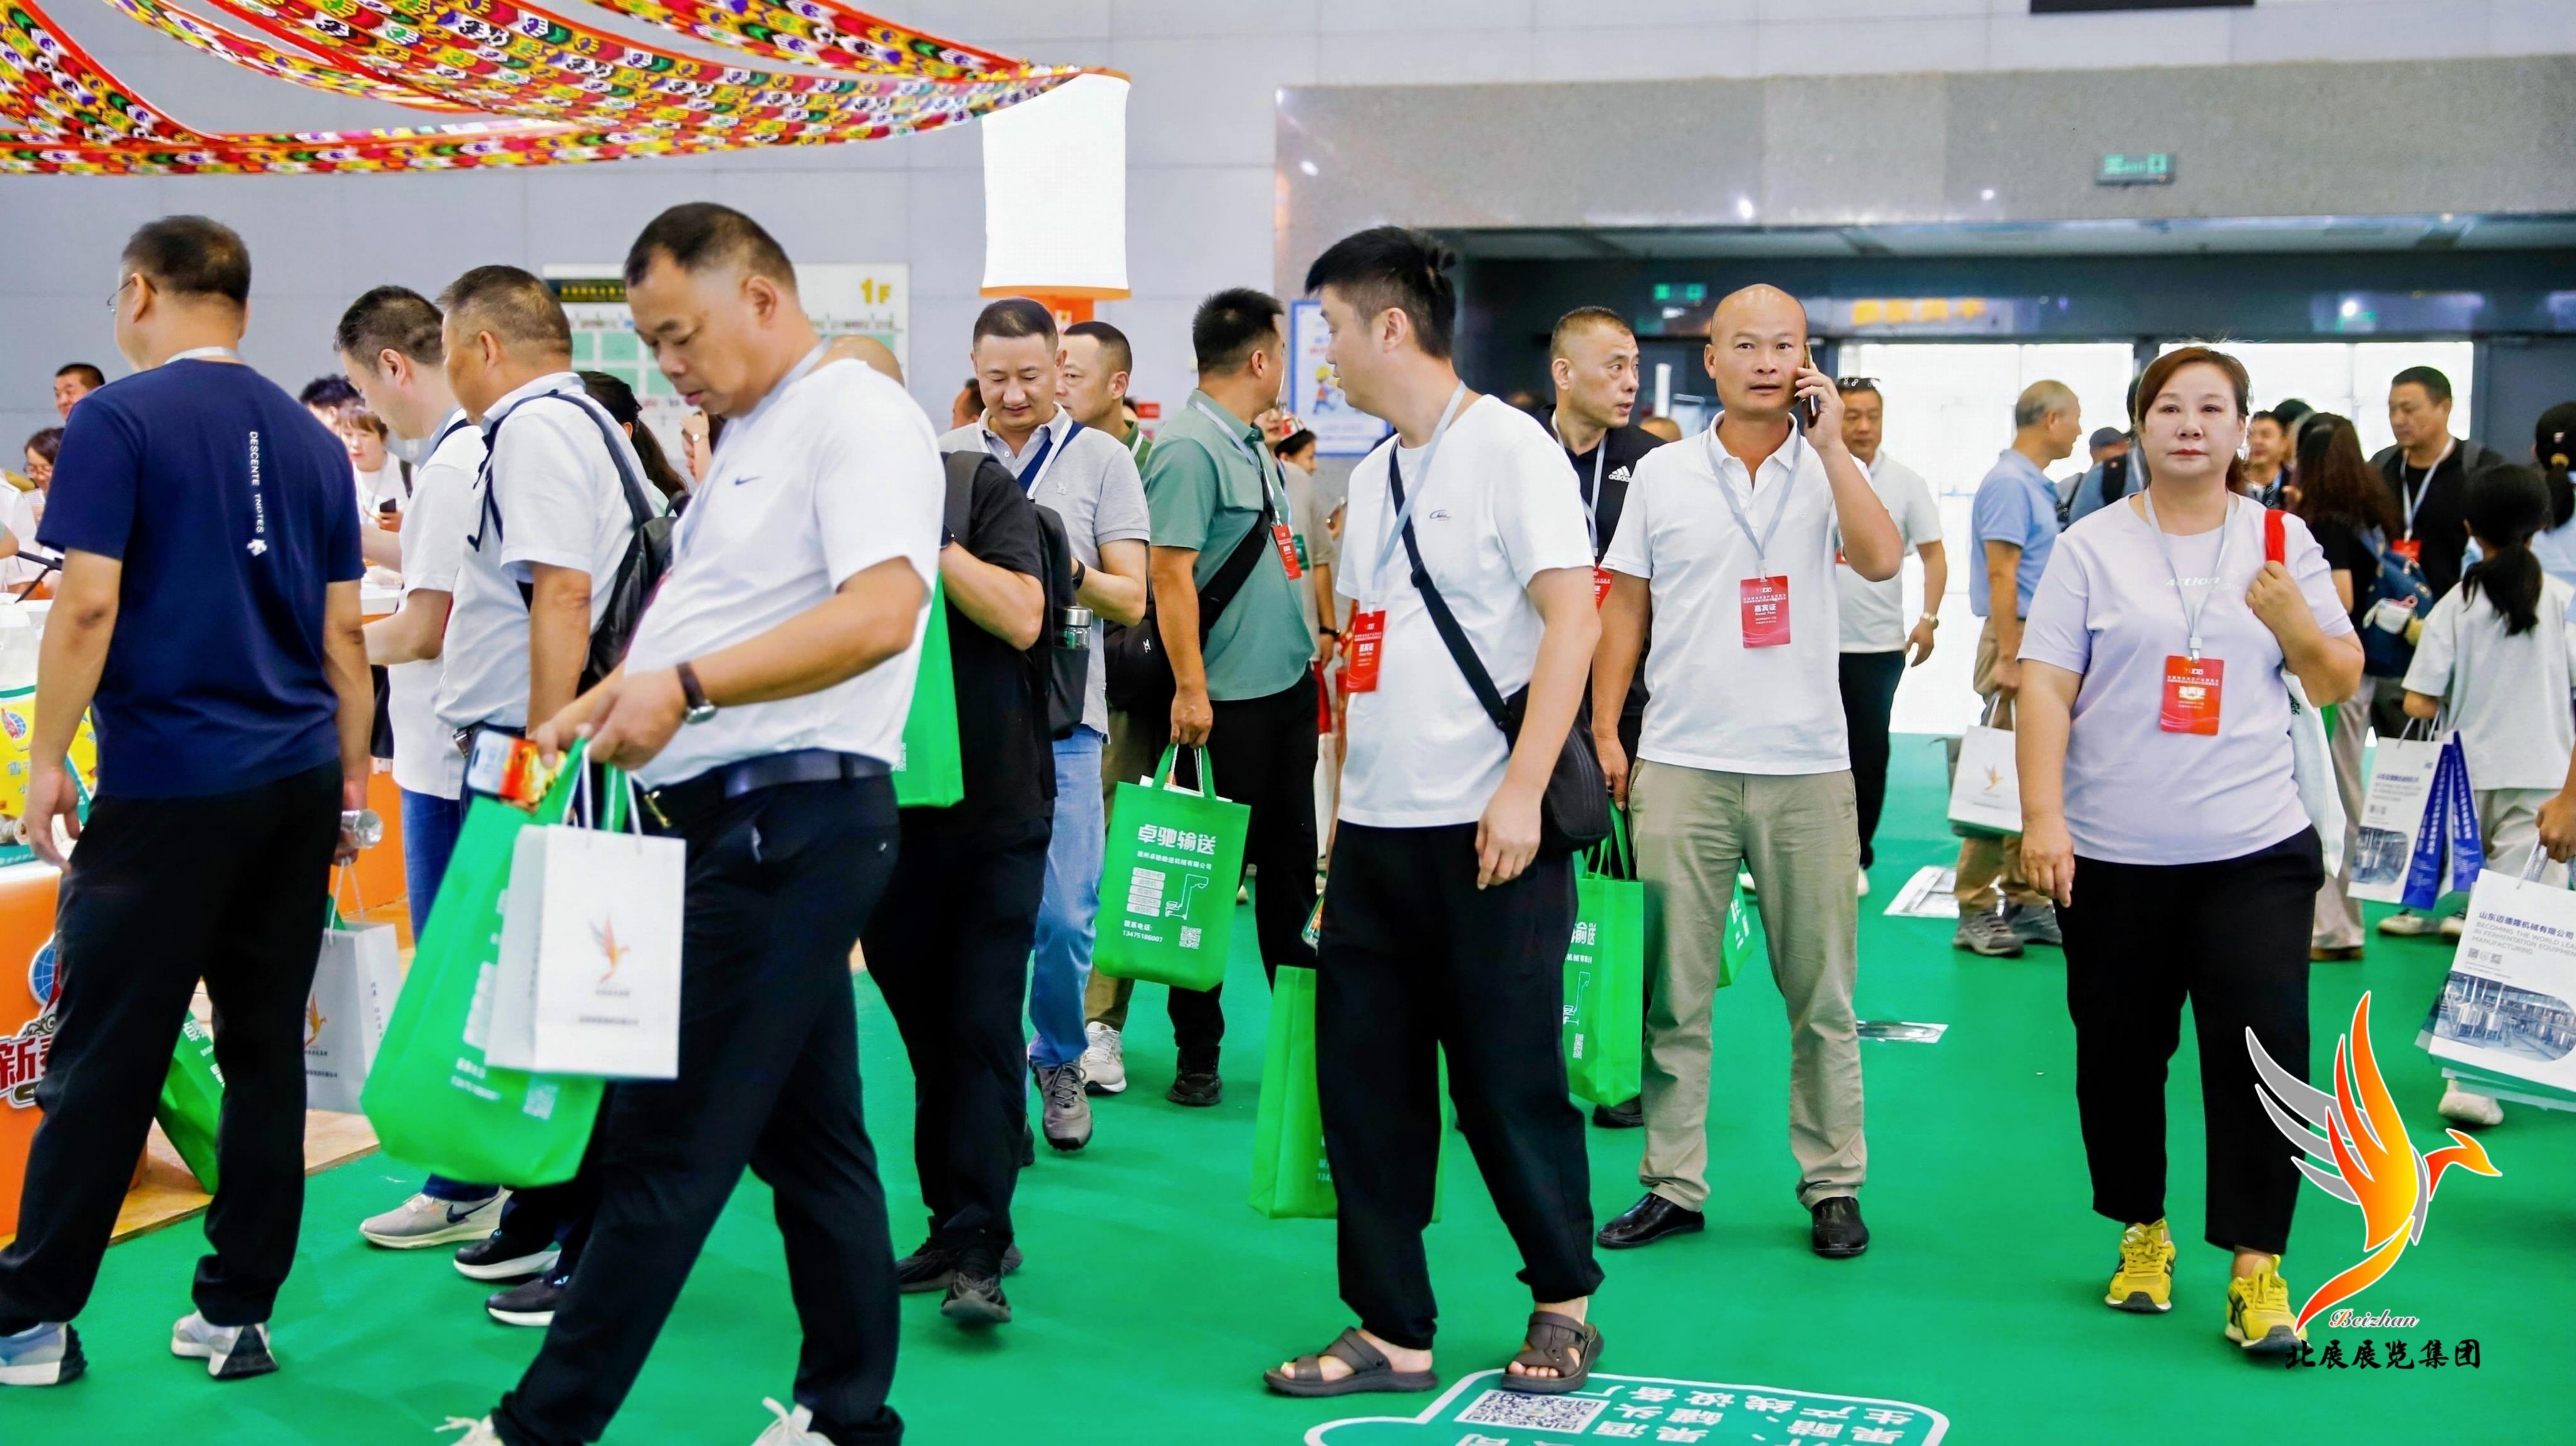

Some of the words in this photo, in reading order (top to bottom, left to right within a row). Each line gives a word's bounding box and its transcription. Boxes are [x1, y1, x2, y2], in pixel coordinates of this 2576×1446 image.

[860, 278, 891, 304] 1F
[250, 431, 260, 486] DESCENTE
[1608, 473, 1630, 482] adida
[1137, 823, 1216, 855] 卓驰输送
[2475, 921, 2514, 935] BECOMING
[2516, 930, 2530, 939] THE
[2532, 933, 2560, 945] WORLD
[2561, 941, 2576, 950] LEA
[2479, 911, 2575, 940] 山东迈德隆机械有限公司
[2484, 930, 2537, 948] FERMENTATION
[2472, 935, 2534, 955] MANUFACTURING
